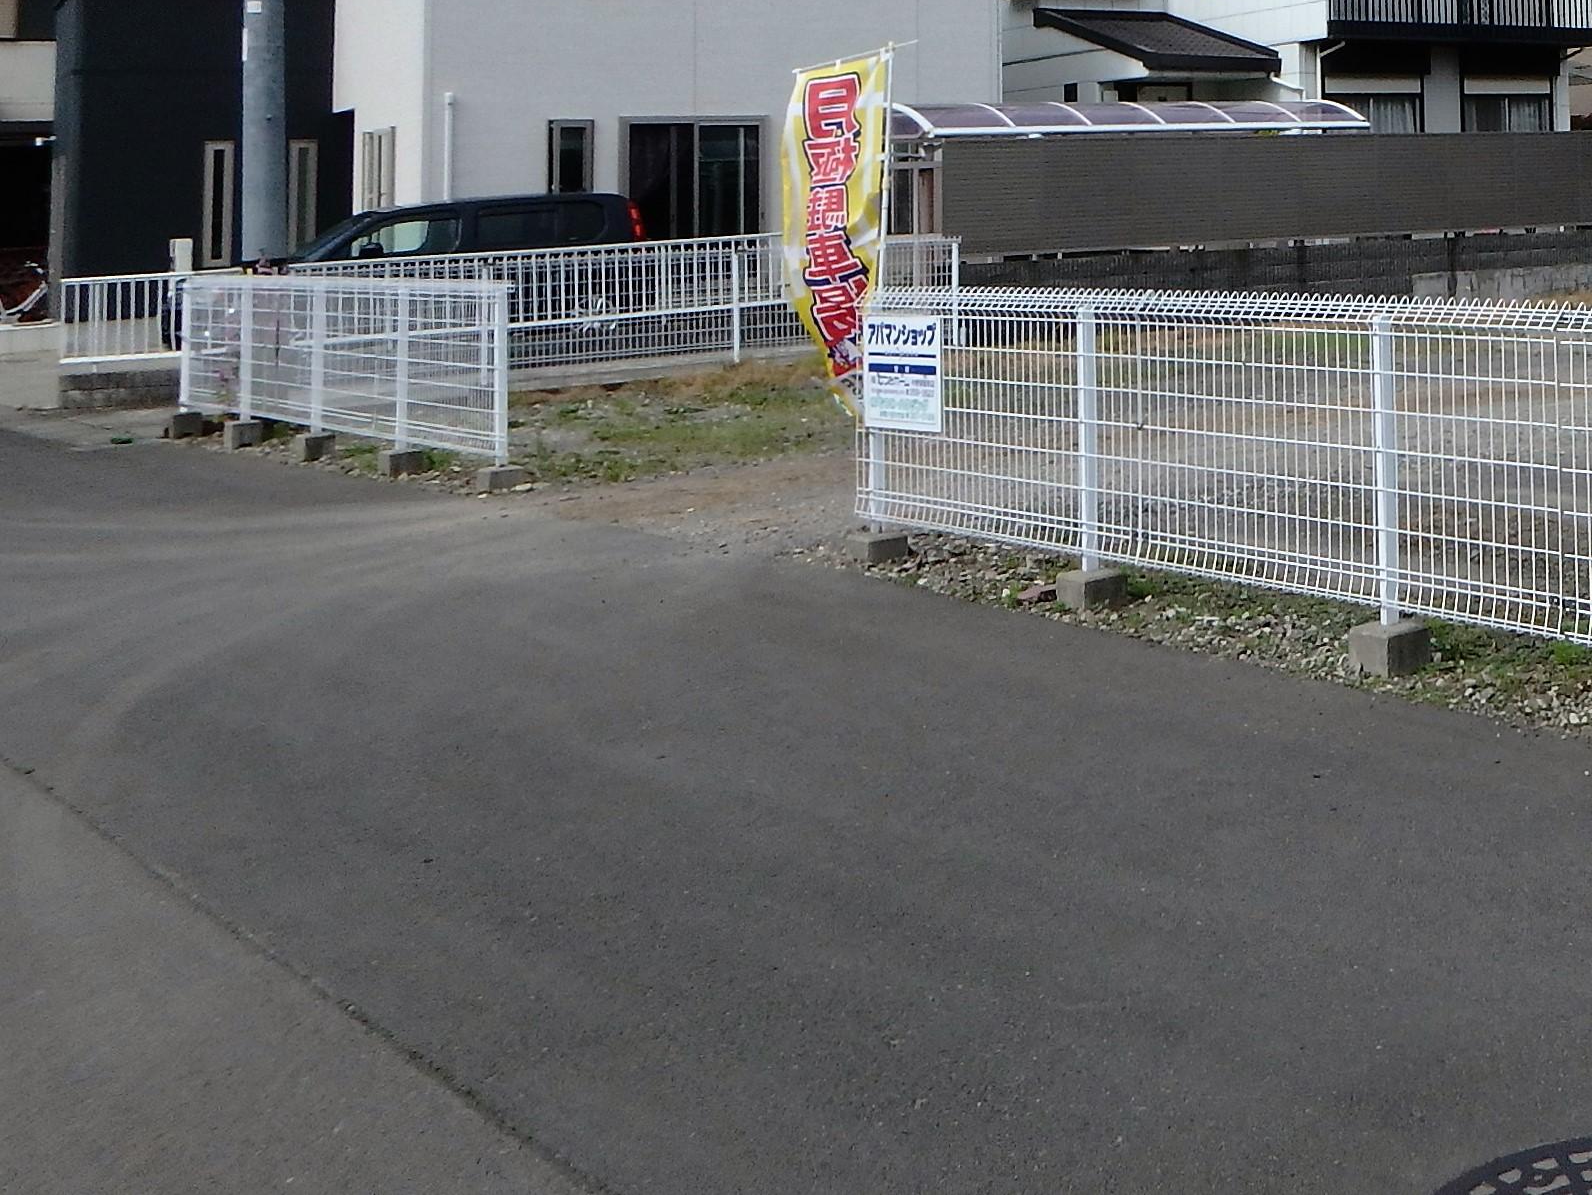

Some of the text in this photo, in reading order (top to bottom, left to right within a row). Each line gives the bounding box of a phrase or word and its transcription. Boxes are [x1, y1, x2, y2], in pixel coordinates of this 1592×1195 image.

[868, 322, 937, 347] アパマンショップ
